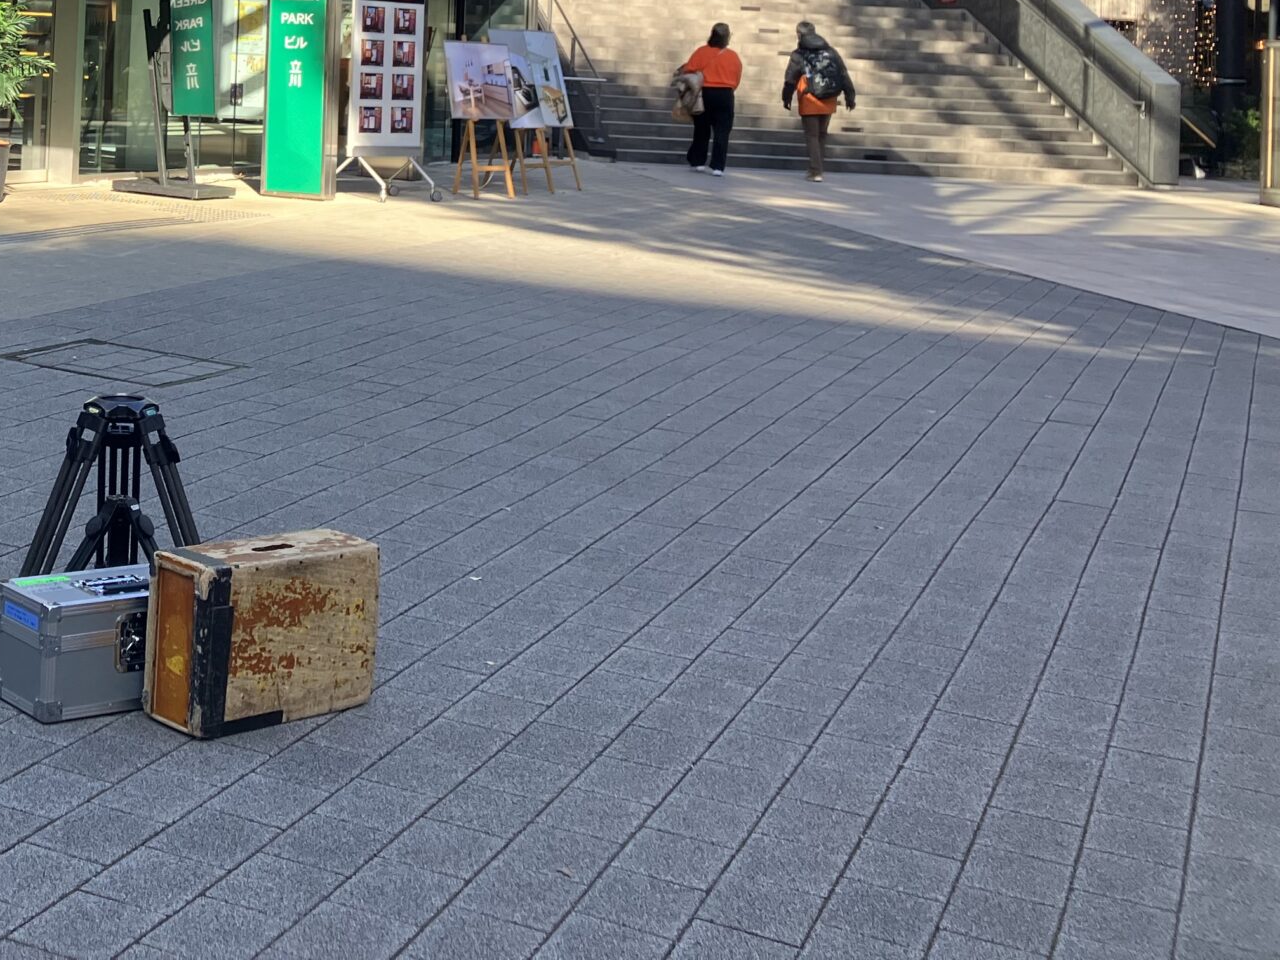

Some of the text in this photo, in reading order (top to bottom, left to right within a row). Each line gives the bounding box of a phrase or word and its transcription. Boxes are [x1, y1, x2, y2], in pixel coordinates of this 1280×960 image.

[281, 13, 314, 25] PARK
[284, 36, 308, 49] ビル
[288, 60, 302, 88] 立川
